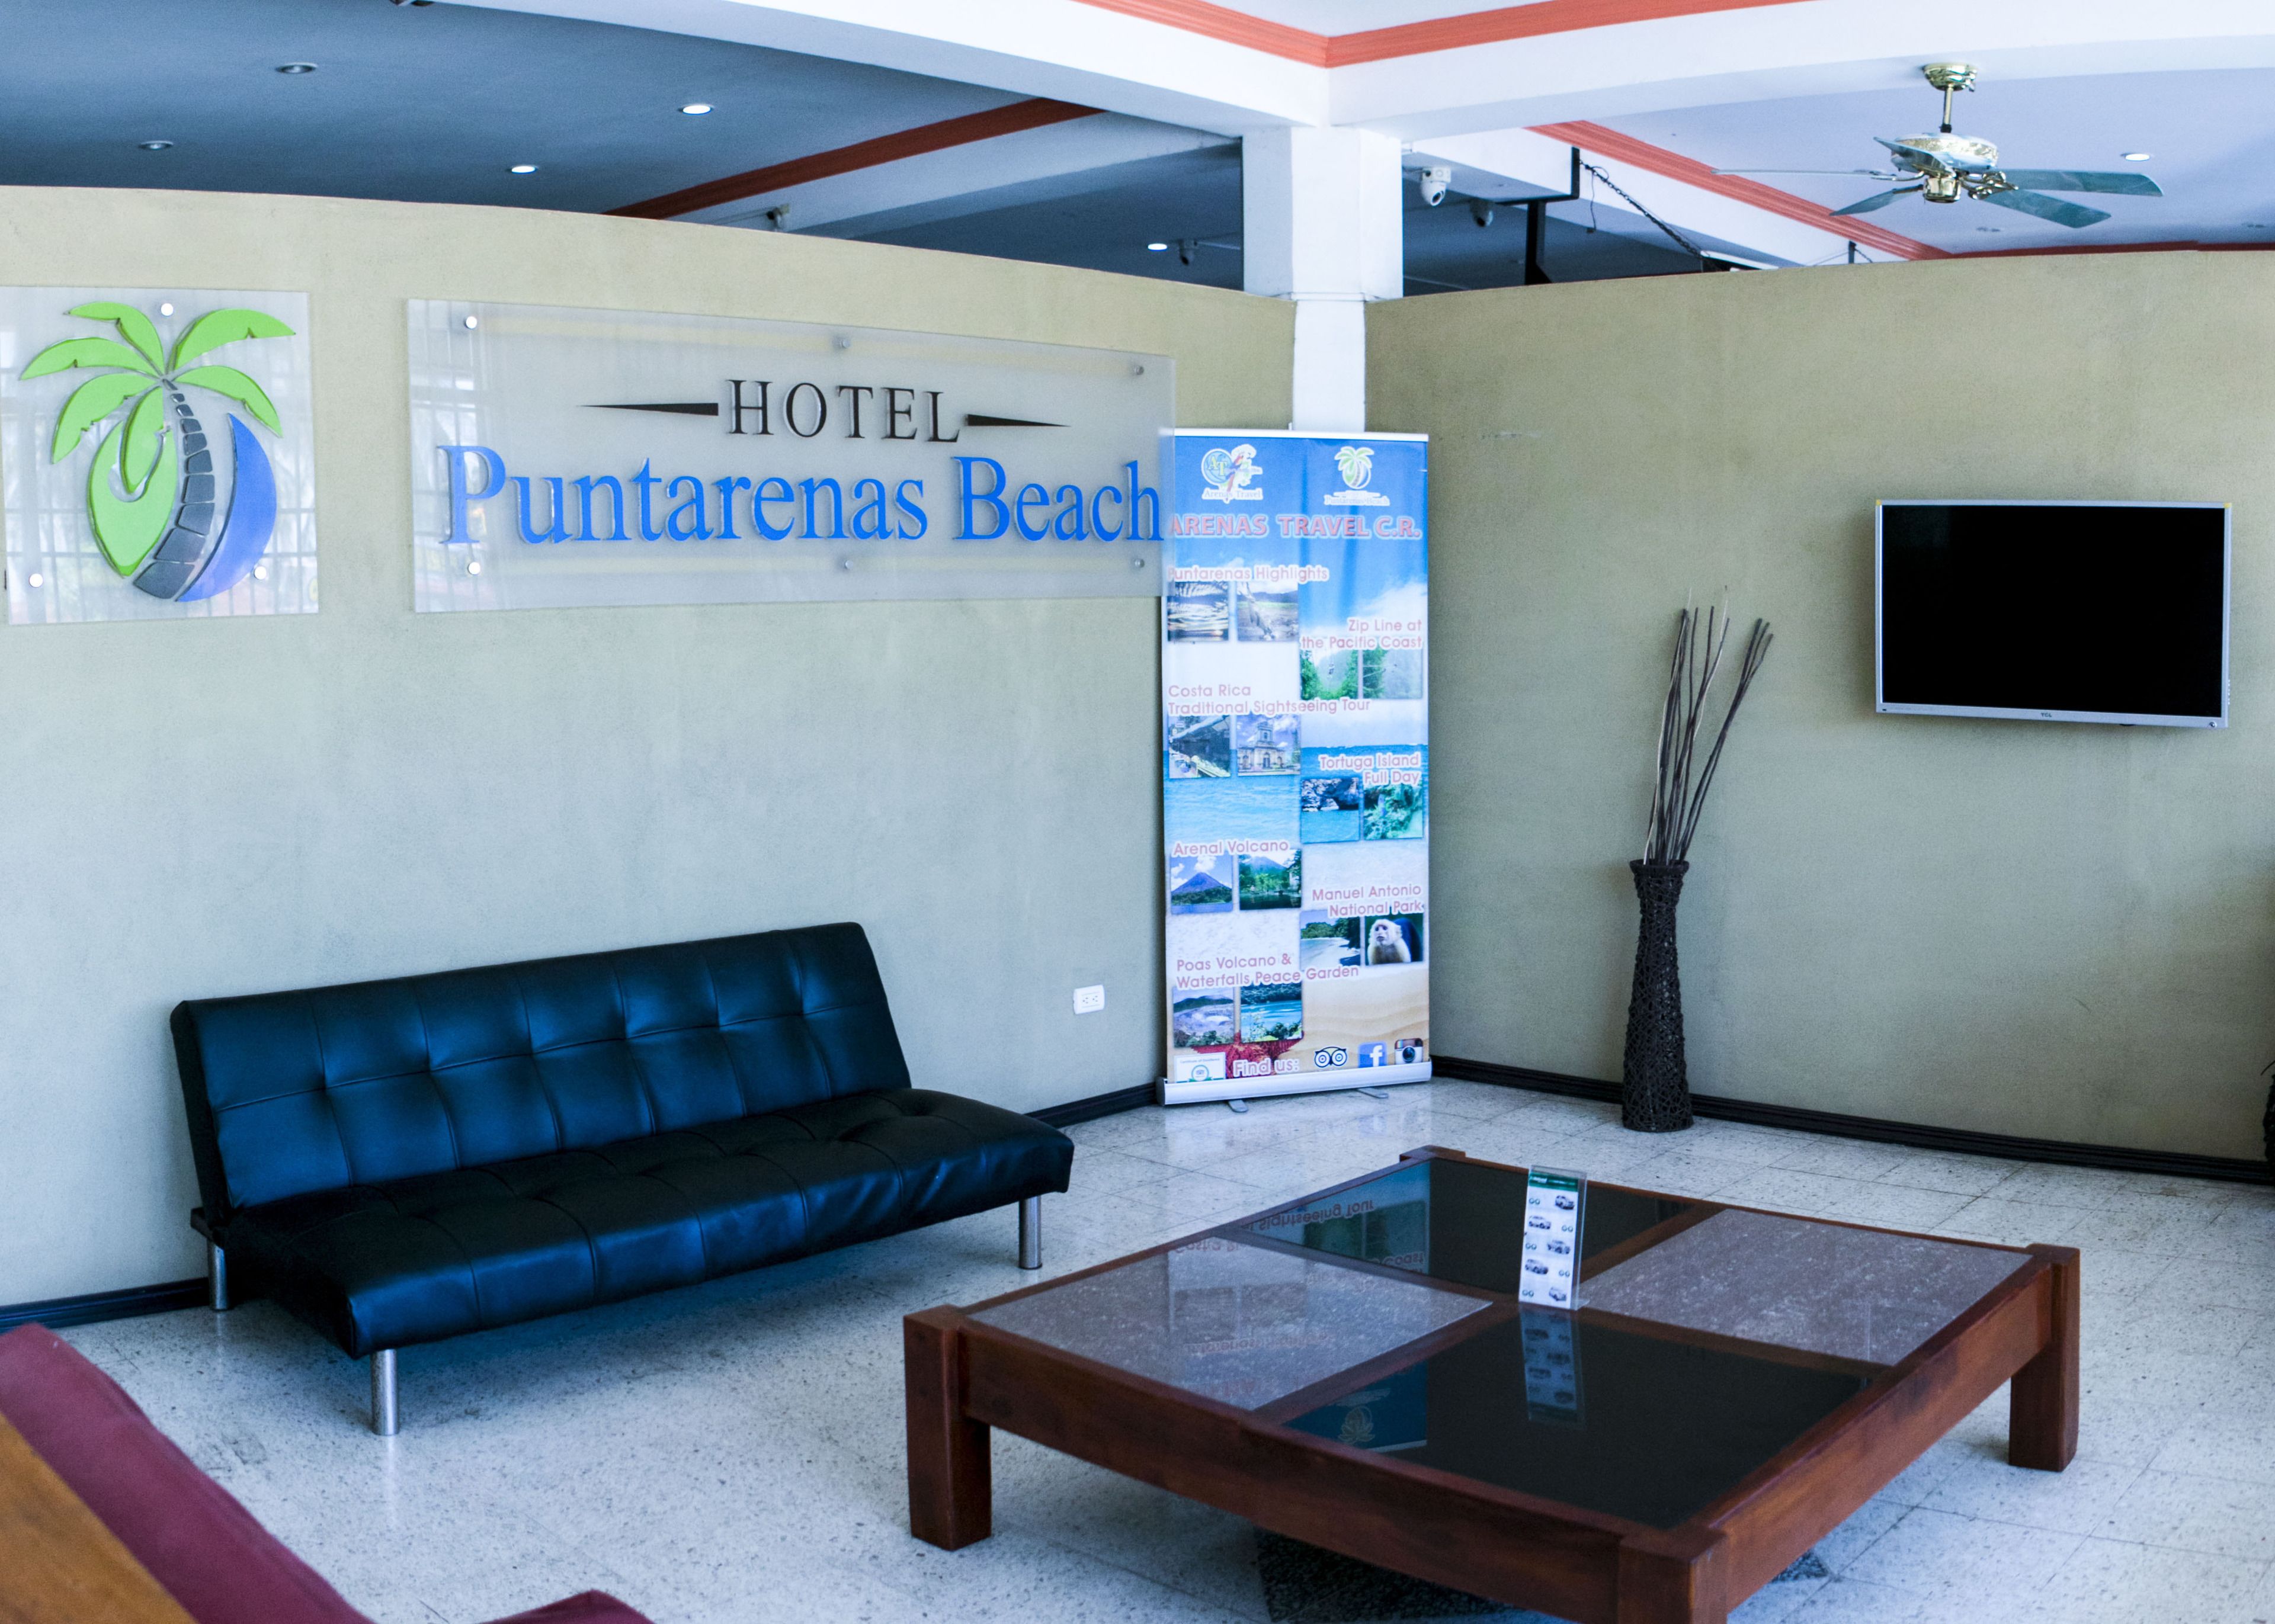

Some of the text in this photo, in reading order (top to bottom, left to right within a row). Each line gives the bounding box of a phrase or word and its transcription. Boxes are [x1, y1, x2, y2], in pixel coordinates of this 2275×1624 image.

[727, 378, 959, 443] HOTEL
[437, 444, 1165, 545] Puntarenas Beach
[1236, 490, 1261, 498] Travel
[1171, 516, 1421, 538] ARENAS TRAVEL C.R.
[1168, 565, 1328, 583] Puntarenas Highlights
[1348, 619, 1422, 634] Zip Line at
[1302, 636, 1422, 649] the Pacific Coast
[1168, 684, 1251, 697] Costa Rica
[1168, 698, 1370, 715] Traditional Sightseeing Tour
[1319, 753, 1420, 771] Tortuga Island
[1364, 771, 1420, 786] Full Day
[1174, 840, 1289, 855] Arenal Volcano
[1312, 884, 1421, 901] Manuel Antonio
[1329, 900, 1422, 916] National Park
[1177, 953, 1292, 972] Poas Volcano &
[1177, 966, 1359, 988] Waterfalls Peace Garden
[1235, 1059, 1299, 1076] Find us:
